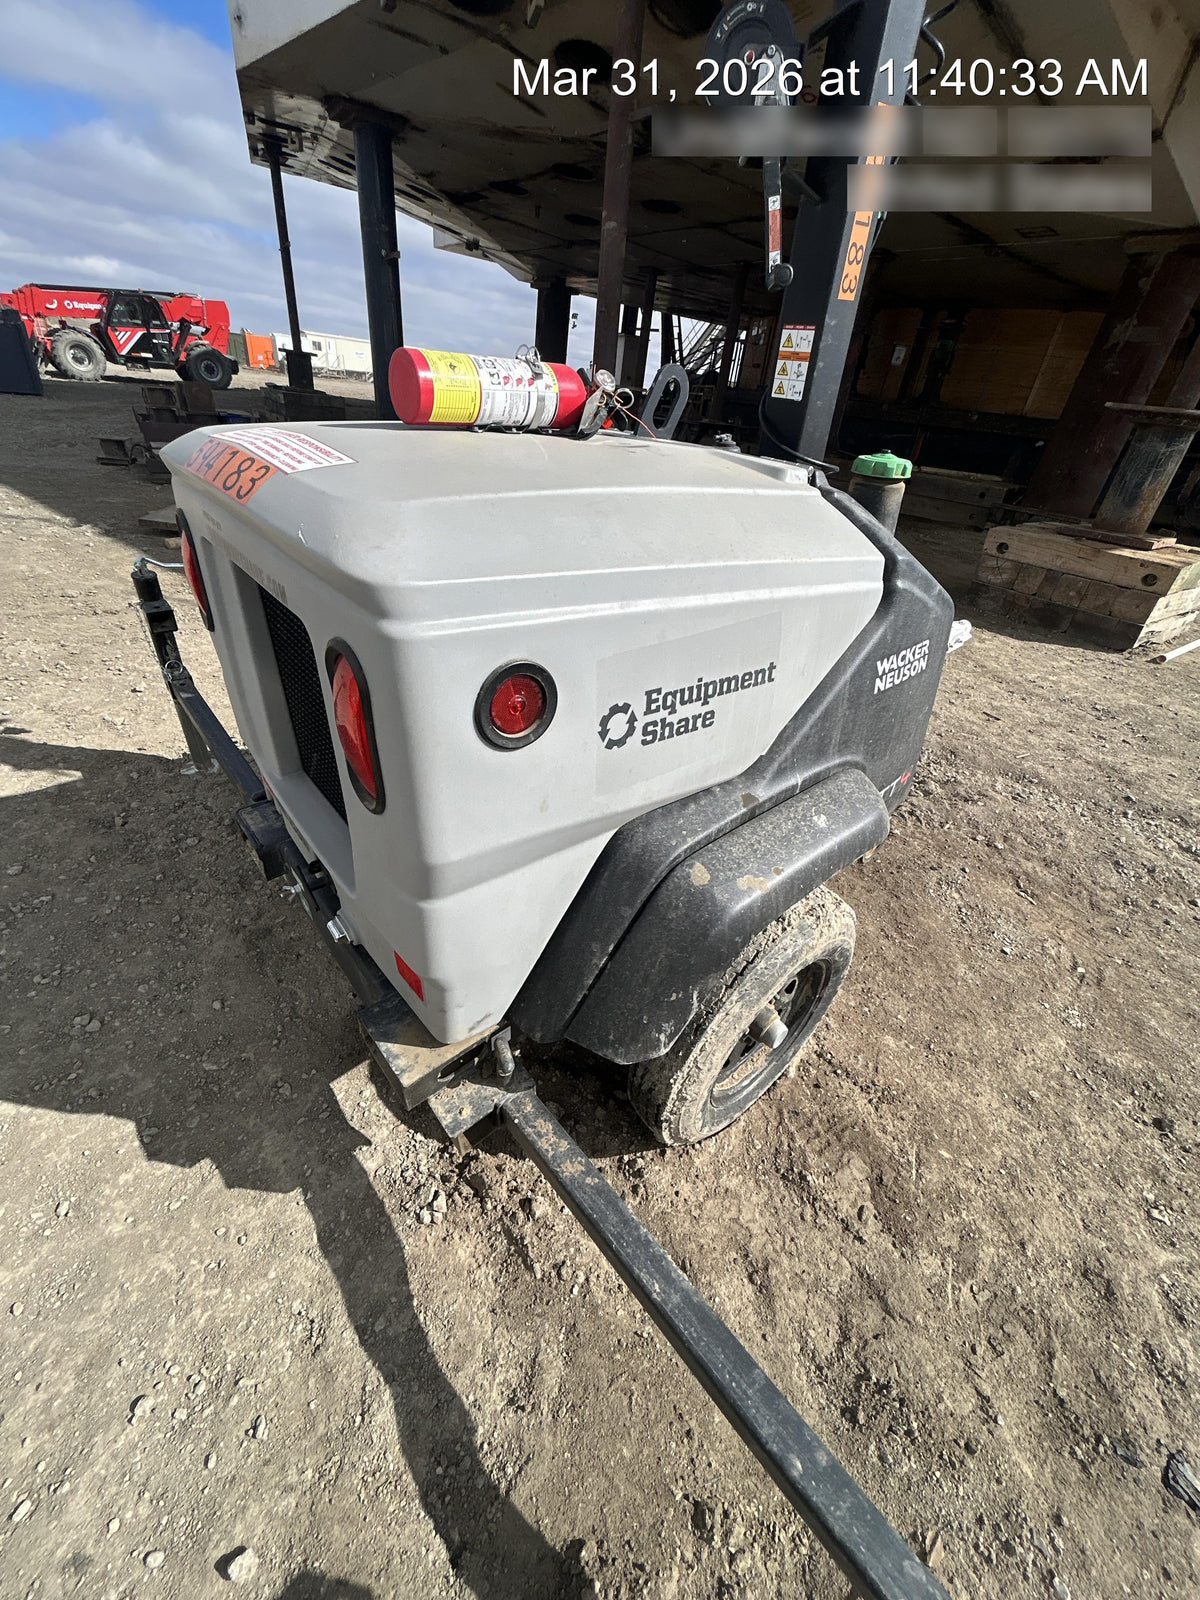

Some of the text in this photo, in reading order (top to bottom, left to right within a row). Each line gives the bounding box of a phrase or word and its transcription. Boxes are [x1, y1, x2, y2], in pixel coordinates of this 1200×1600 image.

[873, 655, 929, 694] NEUSON
[876, 639, 930, 676] WACKER
[642, 661, 777, 716] Equipment
[640, 709, 716, 747] Share
